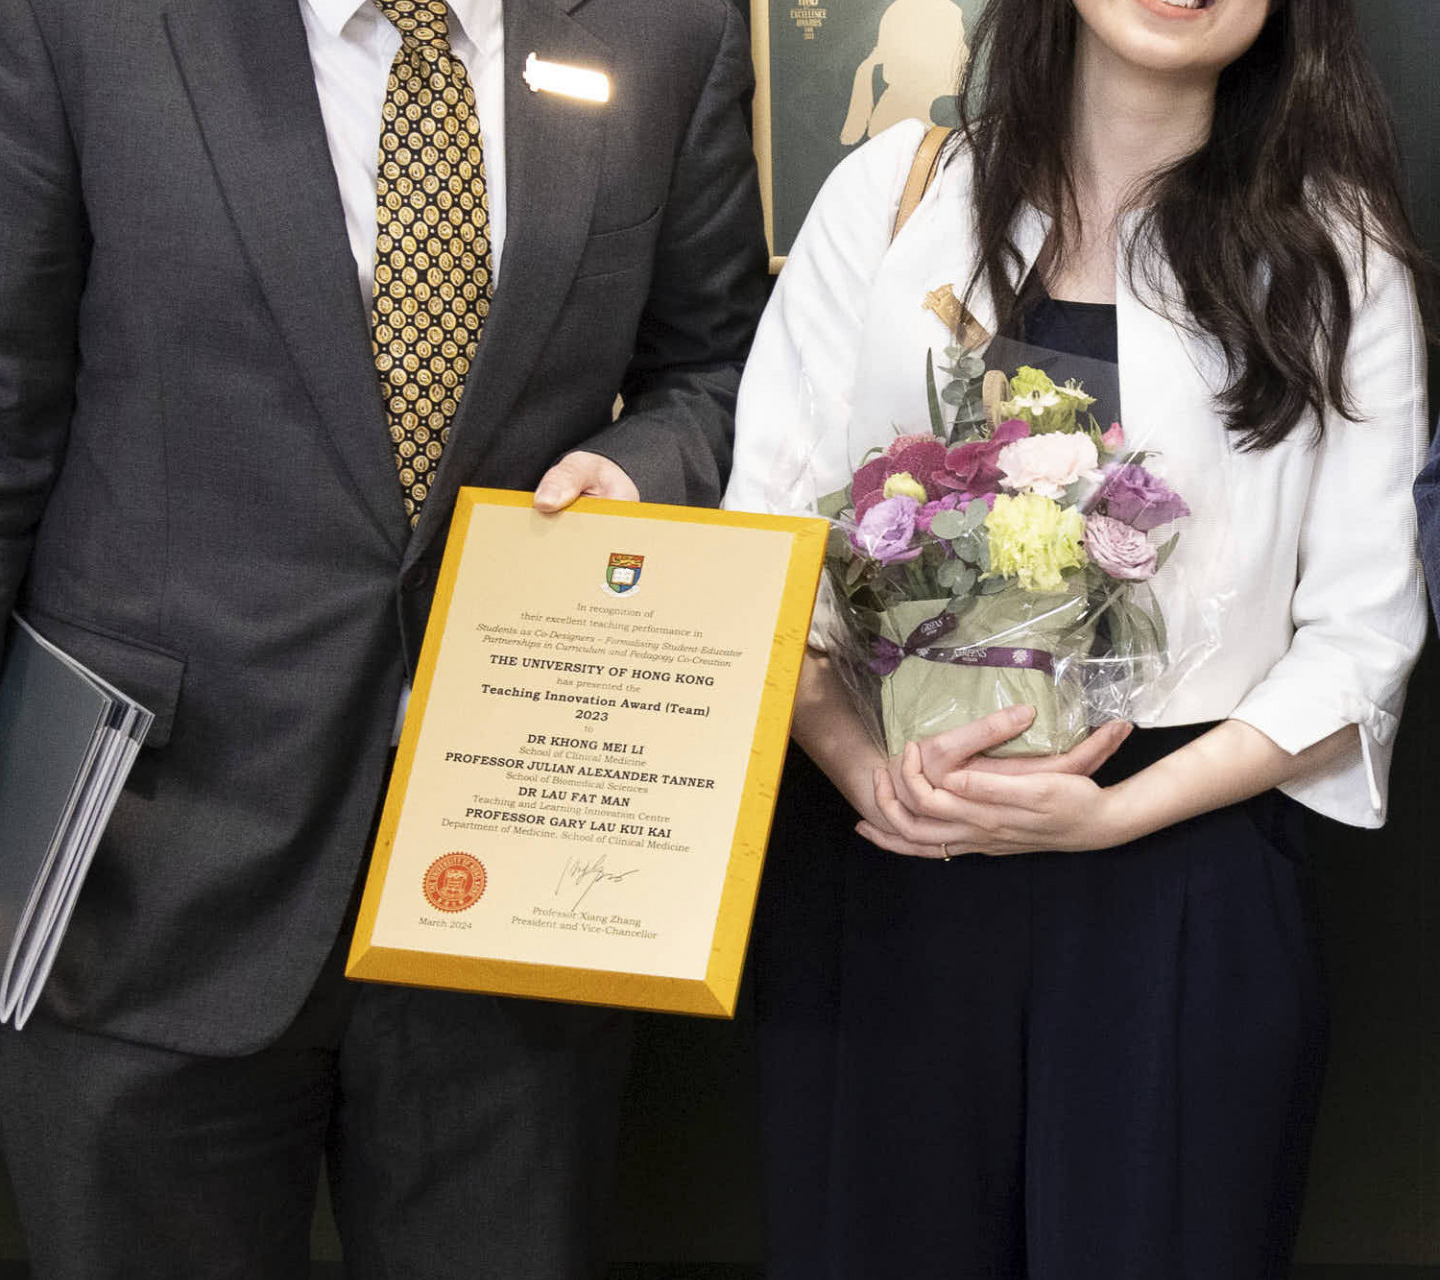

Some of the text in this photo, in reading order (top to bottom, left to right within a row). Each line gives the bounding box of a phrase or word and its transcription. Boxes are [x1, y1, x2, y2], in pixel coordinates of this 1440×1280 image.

[490, 654, 714, 686] THE UNIVERSITY OF HONG KONG
[481, 683, 710, 717] Teaching Innovation Award (Team)
[575, 709, 609, 722] 2023
[527, 734, 644, 755] DR KHONG MEI LI
[445, 752, 715, 789] PROFESSOR JULIAN ALEXANDER TANNER
[518, 786, 630, 807] DR LAU FAT MAN
[465, 808, 672, 838] PROFESSOR GARY LAU KUI KAI
